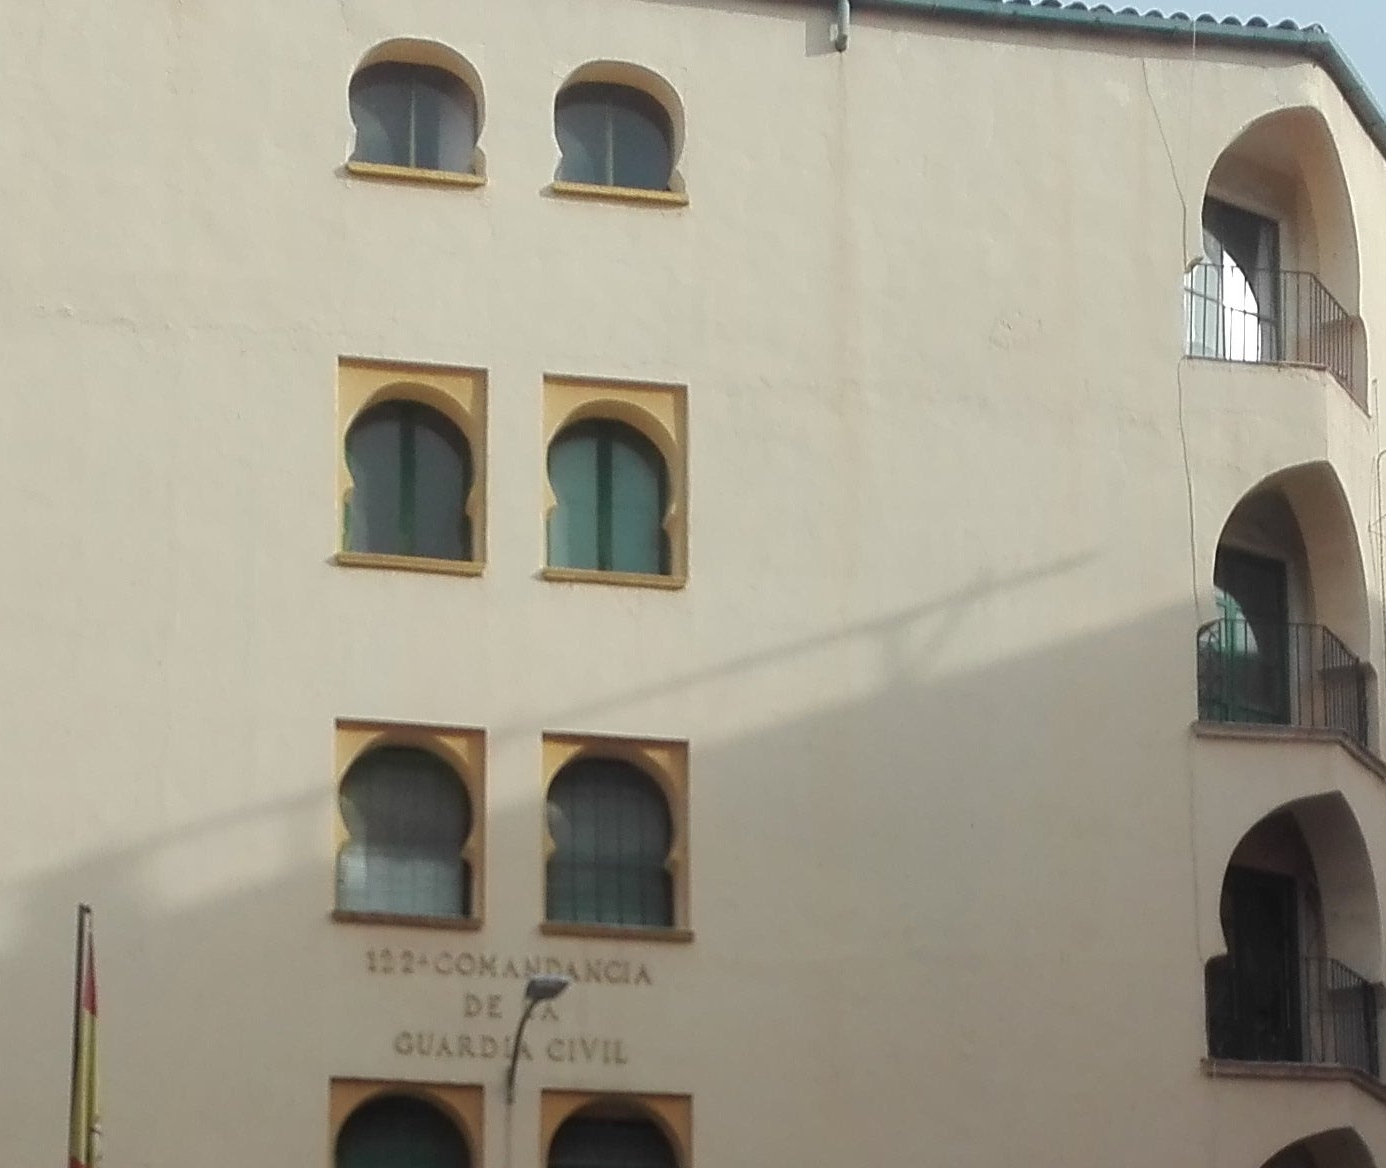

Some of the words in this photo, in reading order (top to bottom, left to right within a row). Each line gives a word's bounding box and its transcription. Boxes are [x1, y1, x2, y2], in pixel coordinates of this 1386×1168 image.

[435, 951, 652, 985] COMANDANCIA
[463, 993, 503, 1019] DE
[393, 1031, 533, 1061] GUARDIA
[547, 1038, 628, 1064] CIVIL
